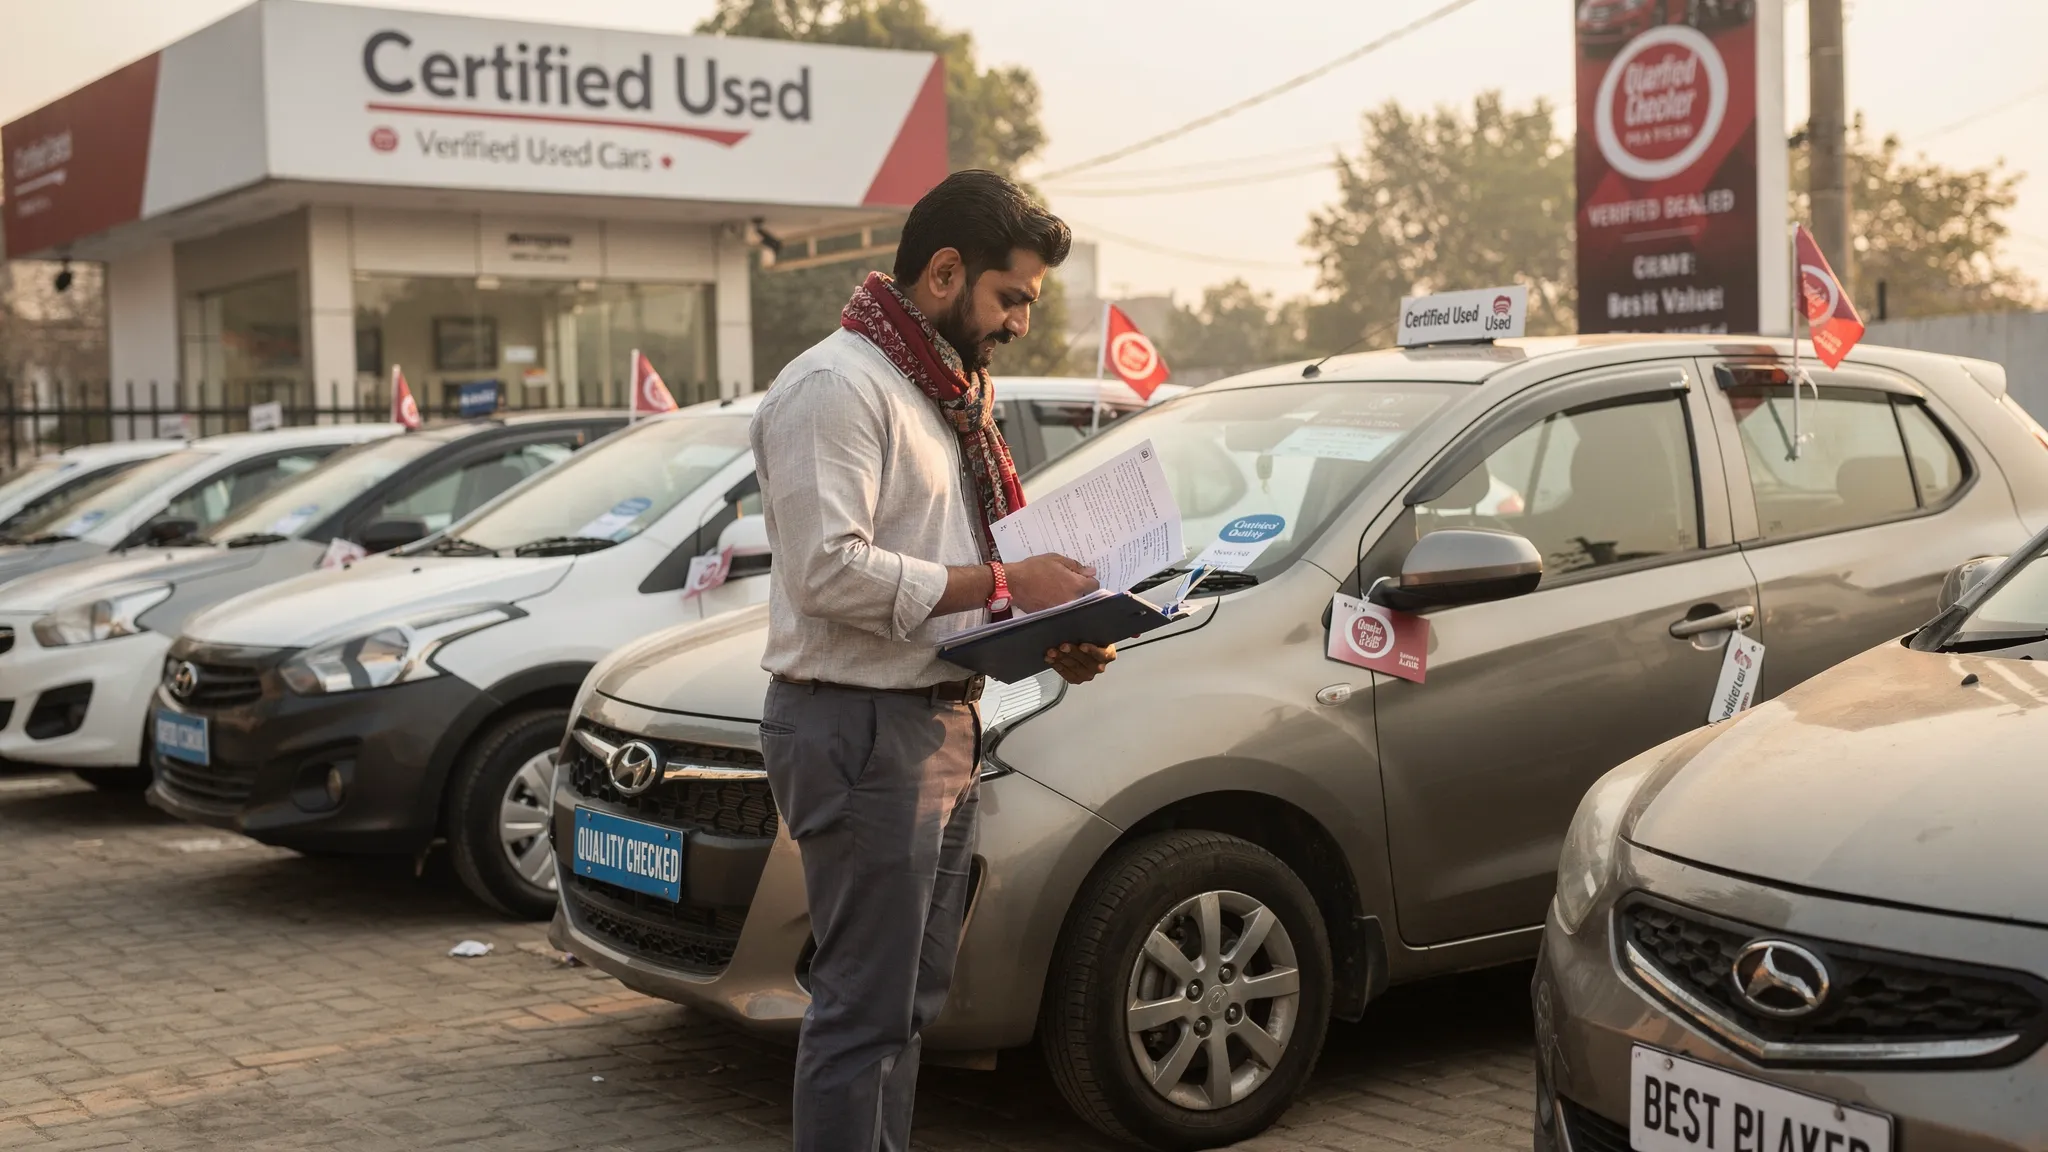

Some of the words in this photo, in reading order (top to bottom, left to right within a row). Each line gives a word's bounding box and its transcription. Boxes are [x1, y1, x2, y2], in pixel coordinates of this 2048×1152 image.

[363, 29, 652, 111] Certified
[415, 128, 520, 164] Verified
[526, 135, 593, 168] Used
[599, 141, 652, 171] Cars
[1587, 198, 1661, 228] VERIFIED
[1405, 307, 1450, 329] Certified
[1452, 304, 1480, 325] Used
[1485, 315, 1512, 331] Used
[578, 826, 625, 870] QUALITY
[626, 838, 679, 883] CHECKED
[1643, 1074, 1721, 1150] BEST
